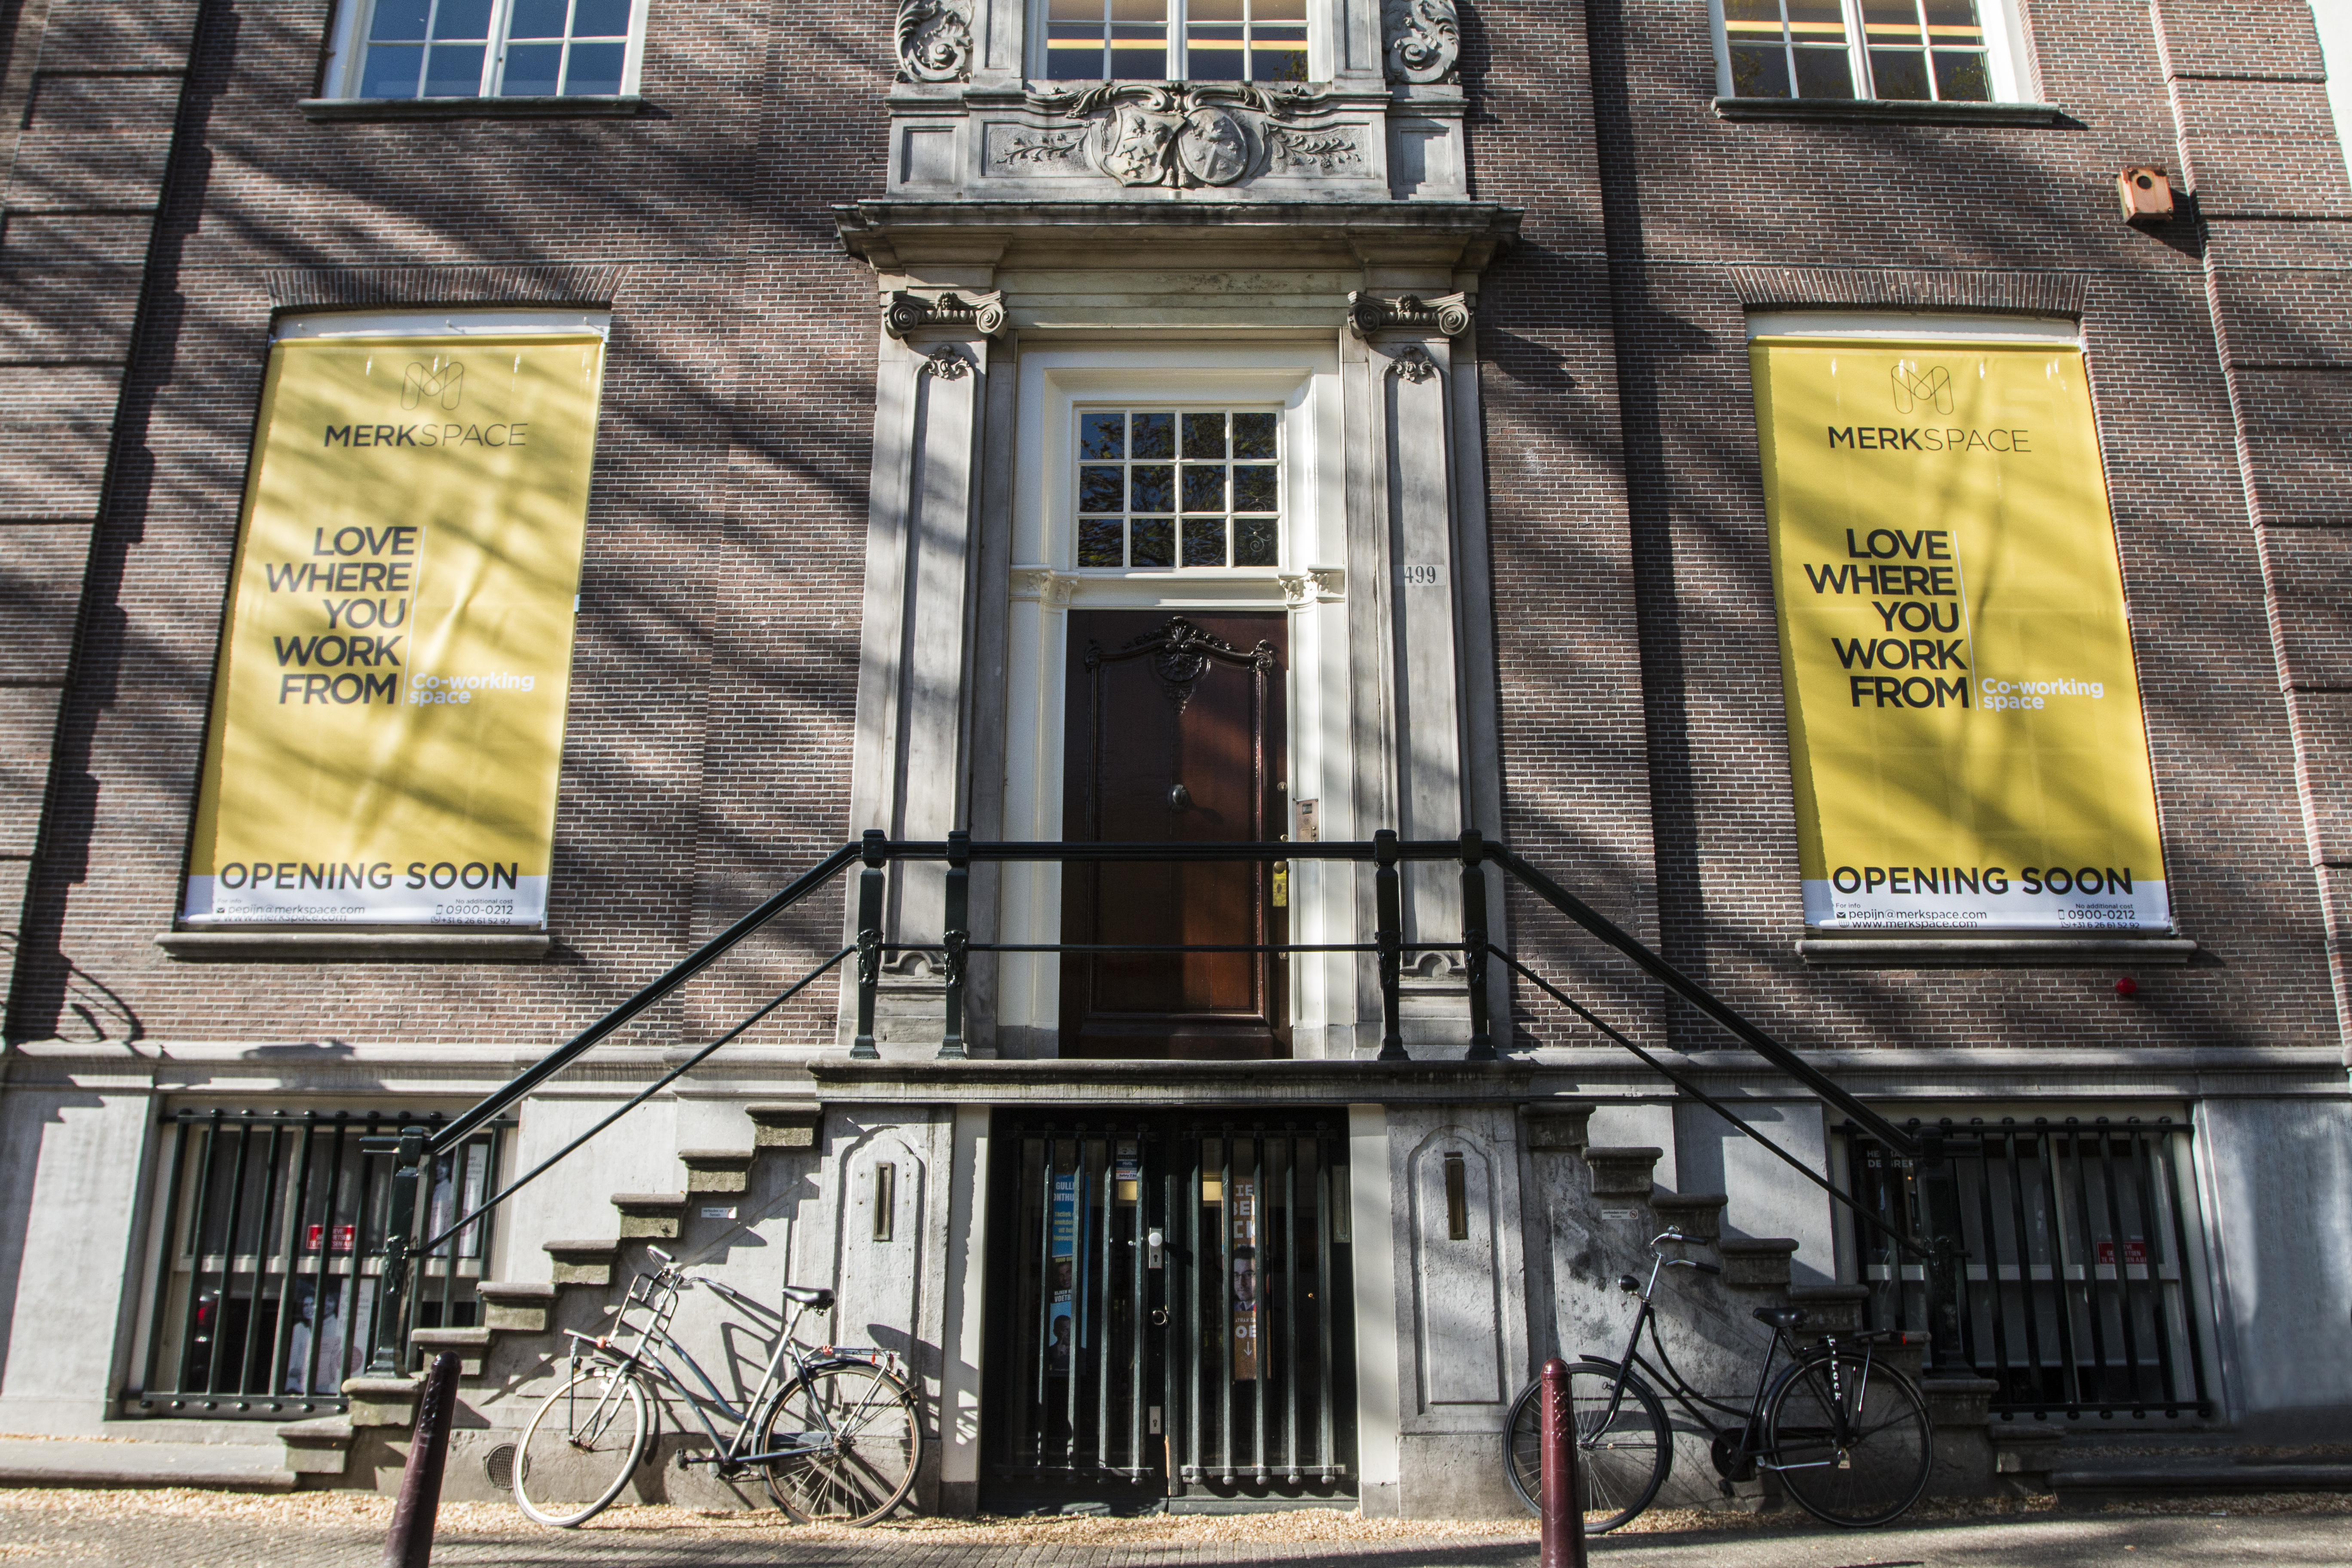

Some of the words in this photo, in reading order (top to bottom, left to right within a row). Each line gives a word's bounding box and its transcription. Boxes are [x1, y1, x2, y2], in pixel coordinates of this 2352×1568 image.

[323, 423, 528, 447] MERKSPACE
[1828, 426, 2032, 452] MERKSPACE
[312, 526, 417, 556] LOVE
[1846, 528, 1951, 560] LOVE
[265, 562, 412, 593] WHERE
[1404, 566, 1436, 584] 499
[1803, 564, 1957, 597] WHERE
[322, 597, 406, 629] YOU
[1871, 601, 1960, 633] YOU
[273, 634, 403, 667] WORK
[1831, 637, 1969, 671] WORK
[279, 673, 397, 705] FROM
[411, 671, 535, 692] Co-working
[1849, 675, 1970, 708] FROM
[1981, 677, 2104, 699] Co-working
[408, 689, 471, 707] space
[1983, 694, 2045, 712] space
[220, 862, 392, 890] OPENING
[405, 861, 518, 891] SOON
[1832, 866, 2009, 895] OPENING
[2021, 866, 2134, 895] SOON
[228, 904, 365, 915] pepijn@merkspace.com
[445, 905, 513, 915] 0900-0212
[1849, 909, 1988, 920] pepijn@merkspace.com
[2068, 910, 2136, 920] 0900-0212
[1852, 920, 1978, 929] www.merkspace.com
